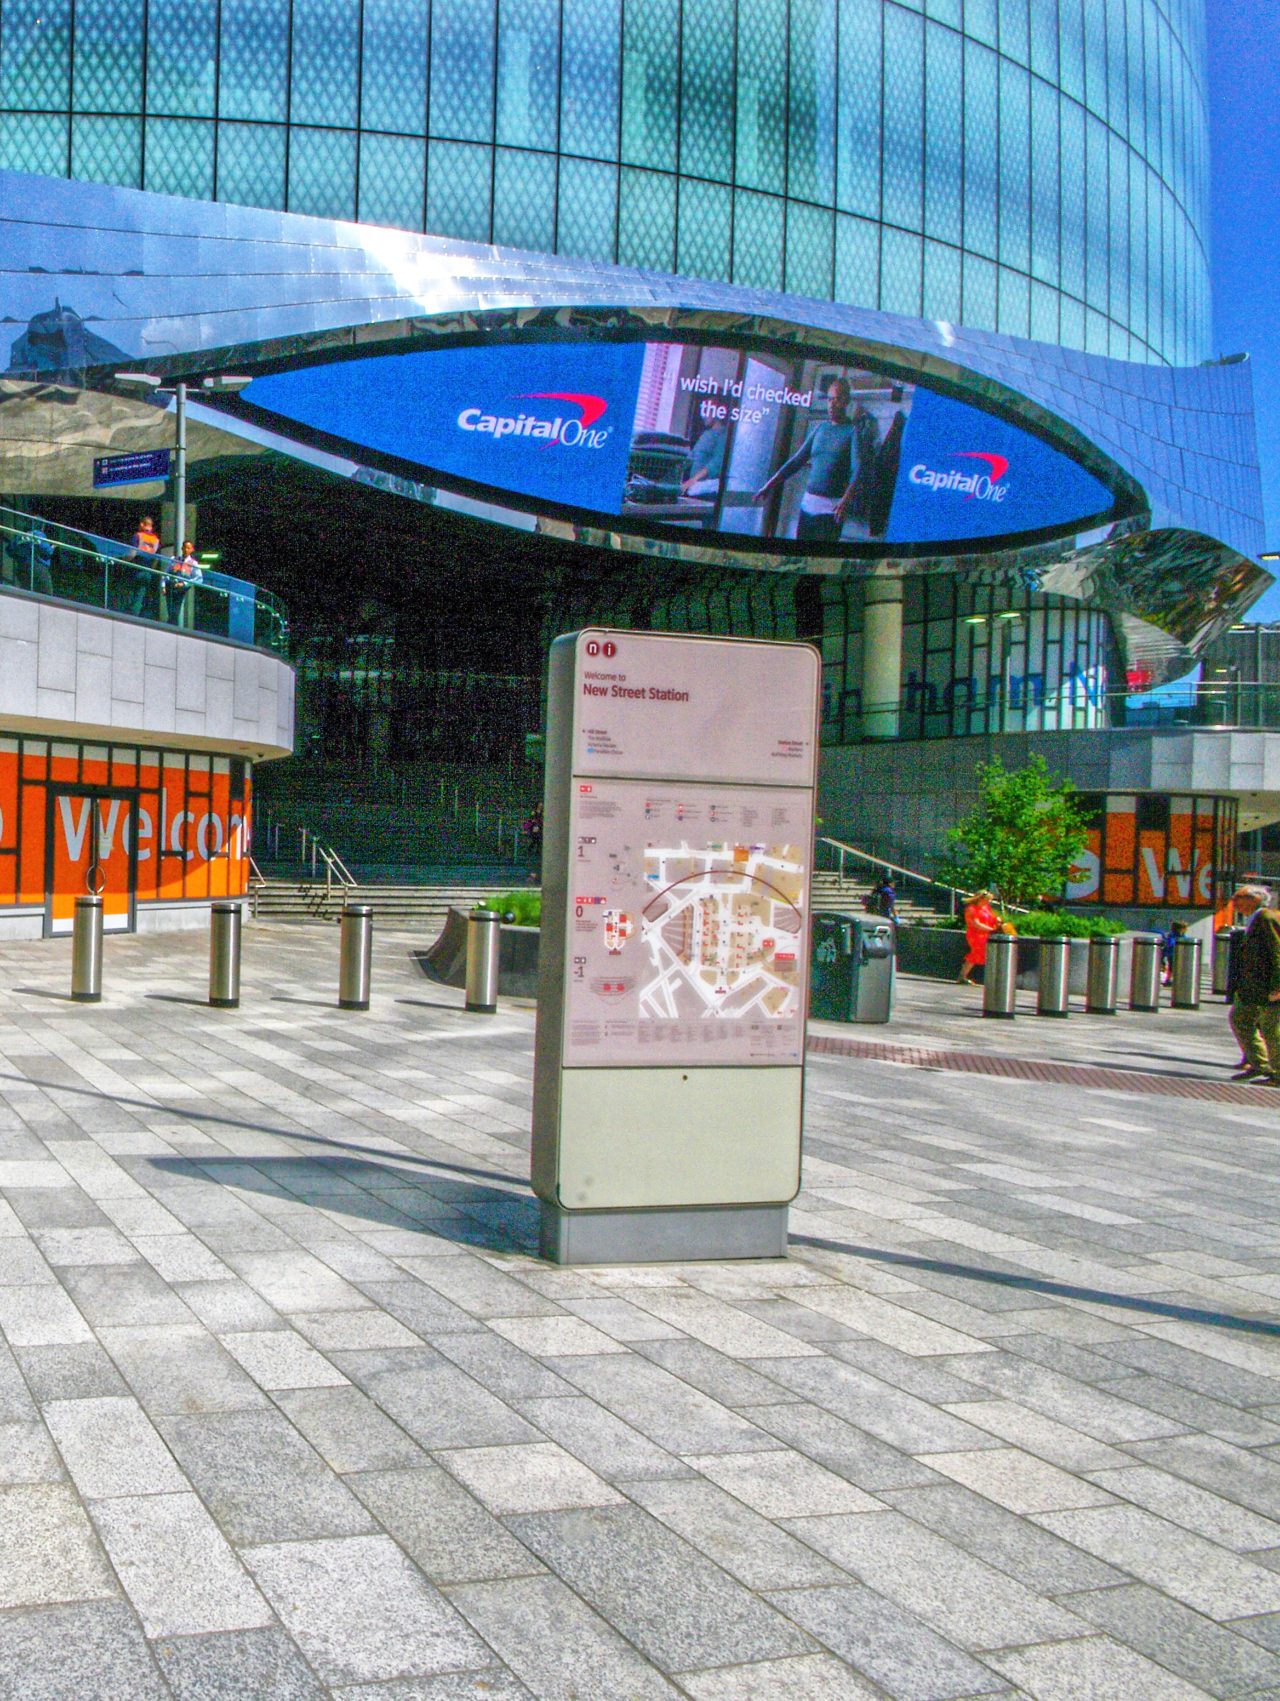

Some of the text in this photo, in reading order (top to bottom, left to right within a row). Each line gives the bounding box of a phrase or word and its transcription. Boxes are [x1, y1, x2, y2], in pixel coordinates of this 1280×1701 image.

[680, 376, 718, 395] wish
[746, 384, 813, 408] checked
[699, 400, 725, 419] the
[584, 671, 626, 682] Welcome to
[583, 684, 689, 702] New Street Station
